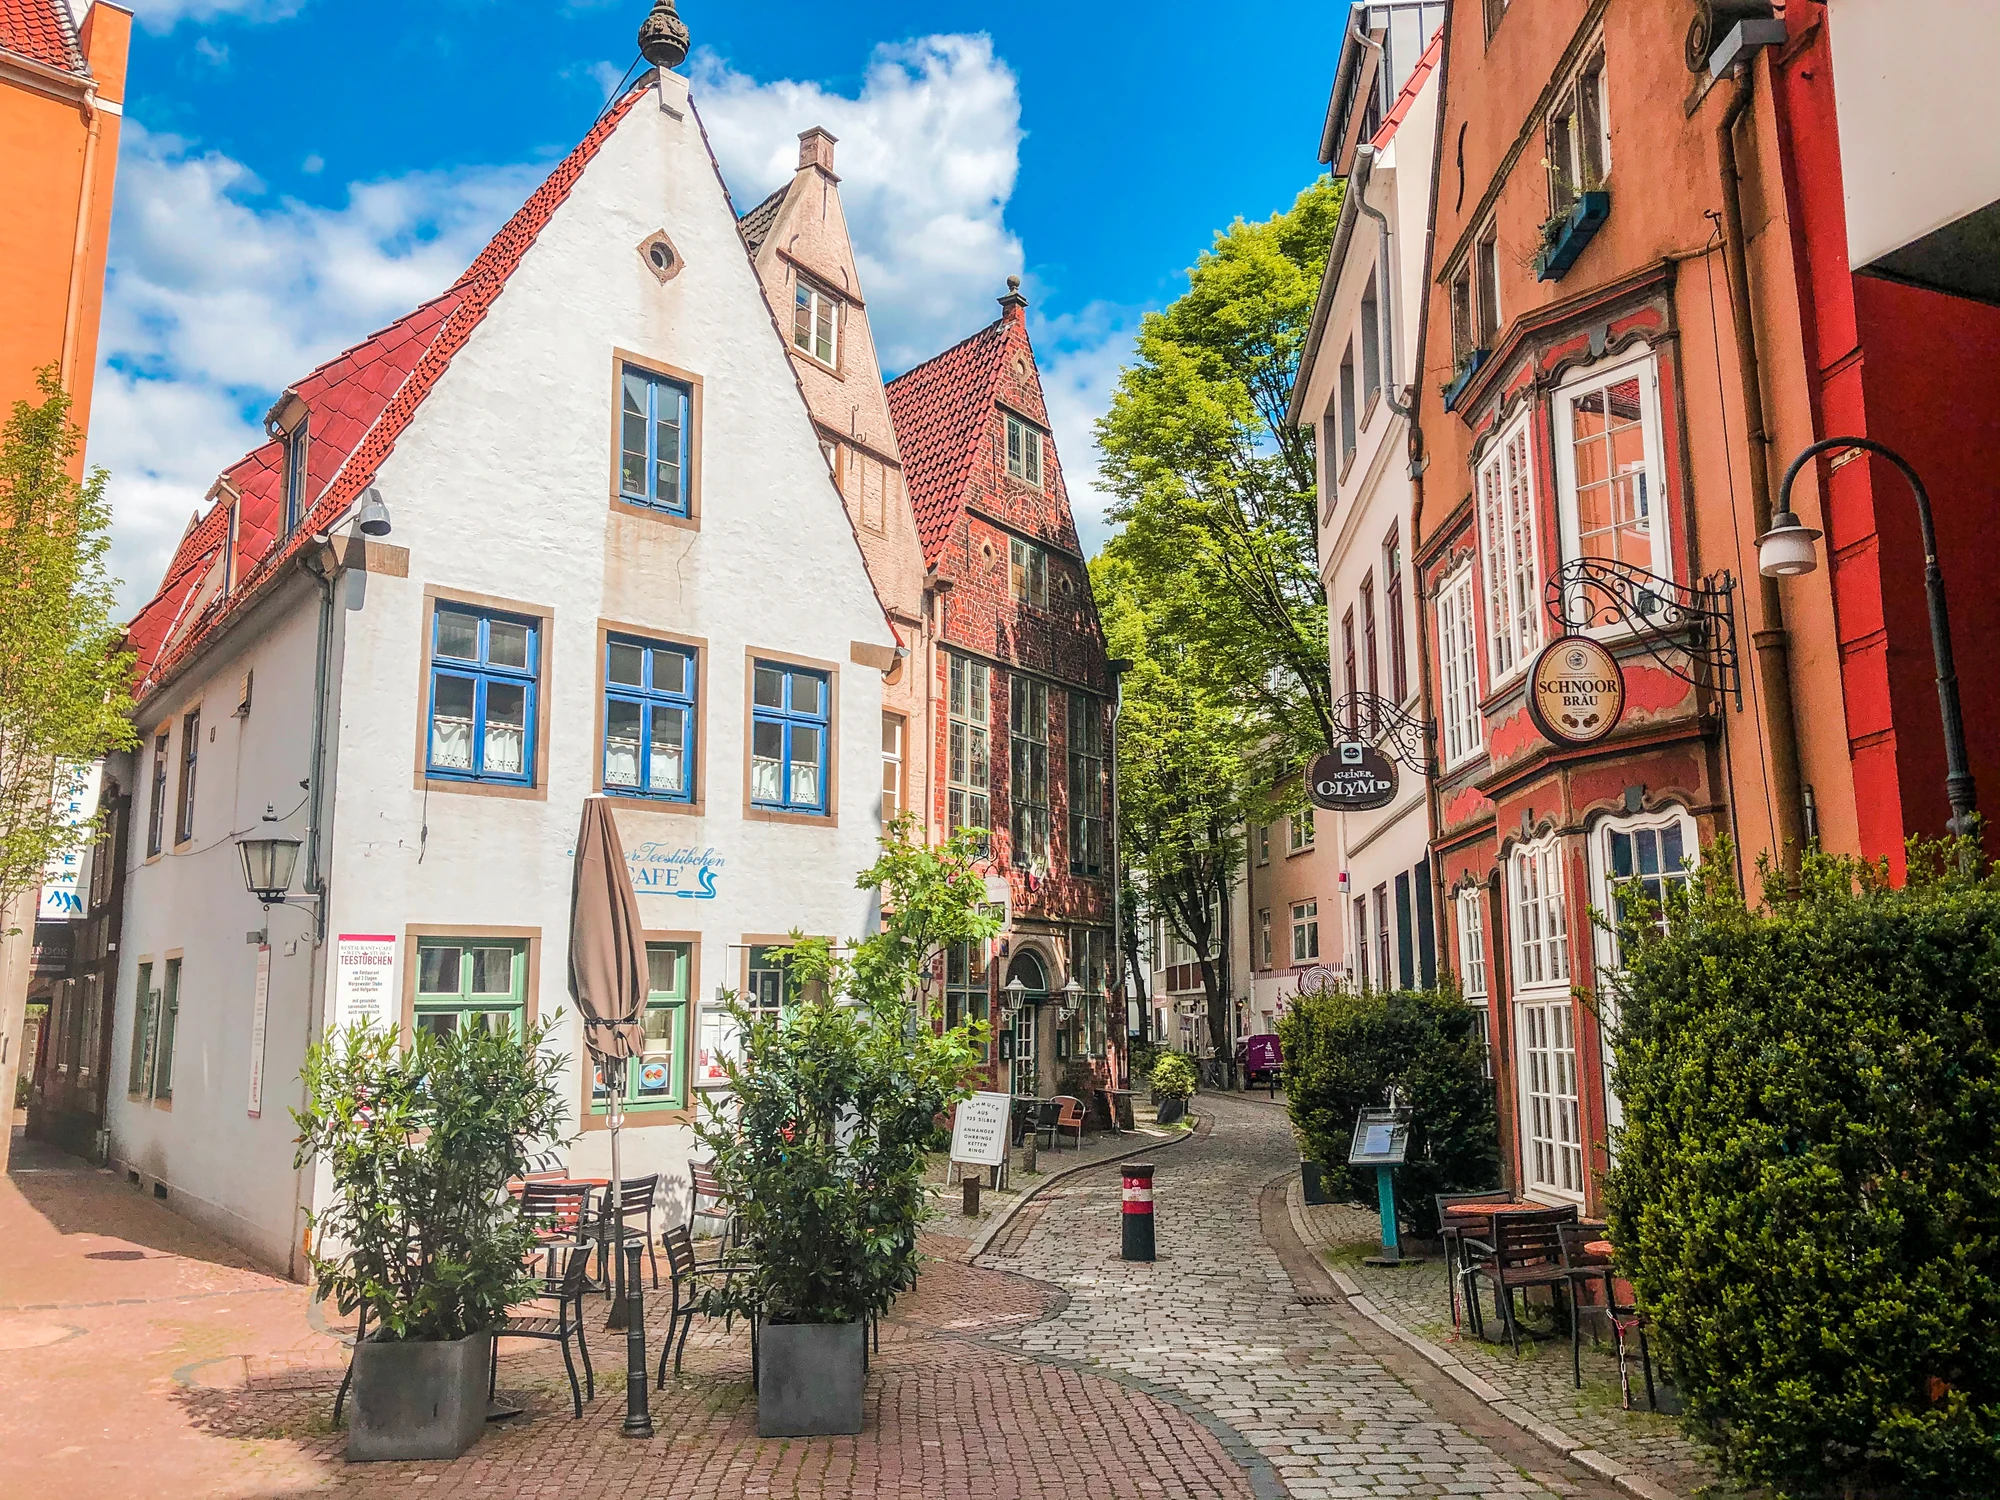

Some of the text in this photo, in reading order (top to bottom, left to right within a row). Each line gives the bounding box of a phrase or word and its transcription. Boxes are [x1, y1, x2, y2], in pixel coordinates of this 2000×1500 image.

[1539, 680, 1617, 693] SCHNOOR
[1563, 693, 1598, 706] BRÄU
[640, 841, 726, 867] Teestübchen
[340, 955, 393, 965] TEESTÜBCHEN
[968, 1102, 999, 1111] SCHMUCK
